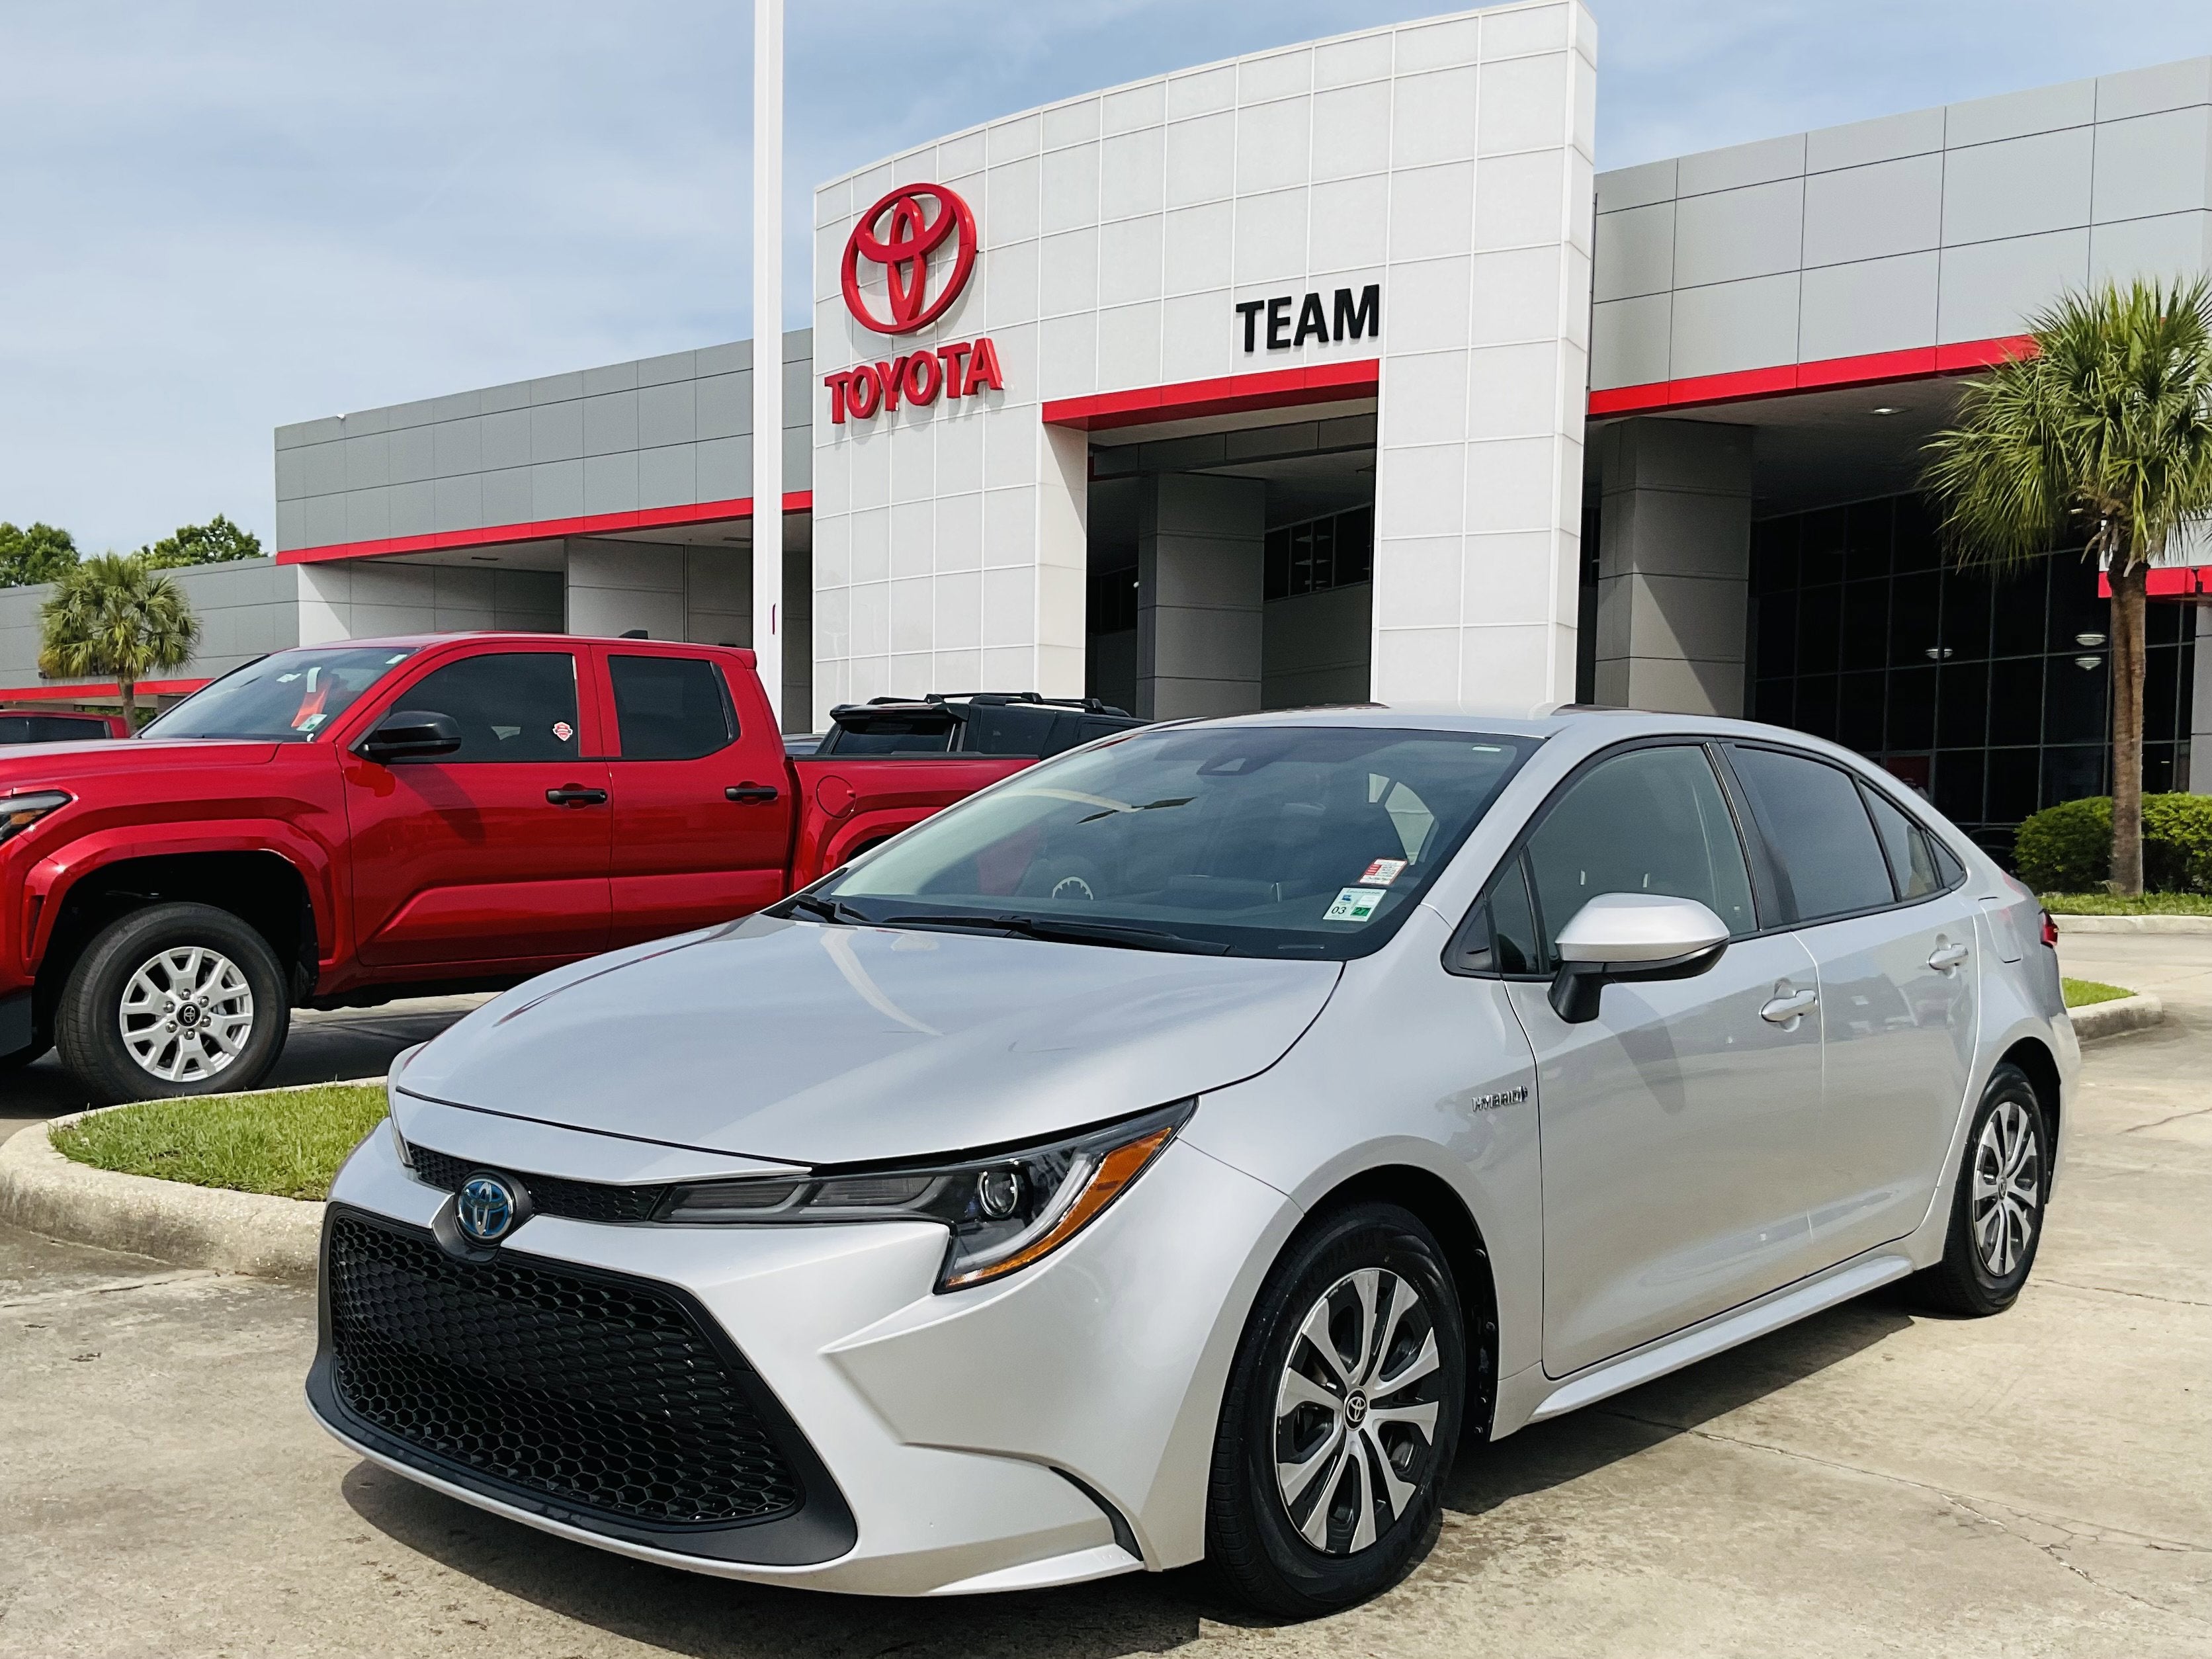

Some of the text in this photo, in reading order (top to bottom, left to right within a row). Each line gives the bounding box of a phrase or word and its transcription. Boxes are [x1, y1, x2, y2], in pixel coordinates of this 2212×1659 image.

[1236, 284, 1380, 353] TEAM
[824, 337, 1004, 424] TOYOTA
[1331, 906, 1347, 915] 03
[1472, 1085, 1528, 1111] HYBRID
